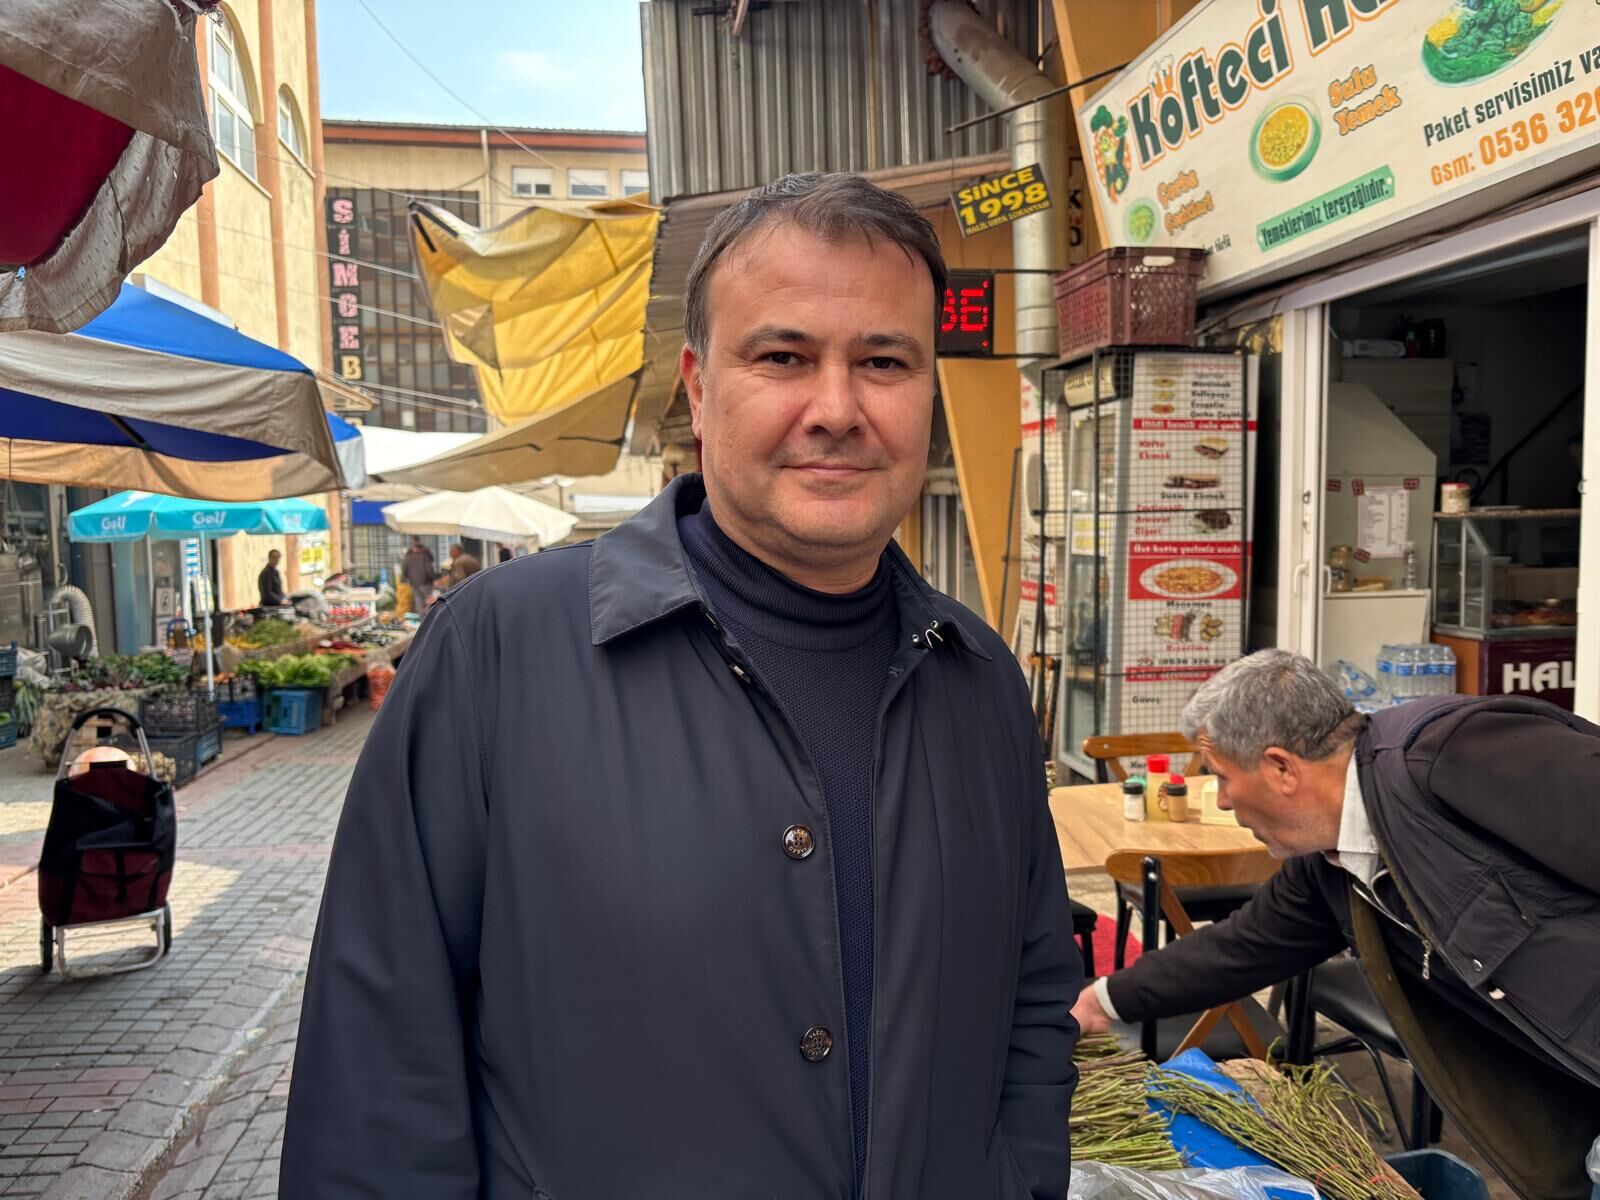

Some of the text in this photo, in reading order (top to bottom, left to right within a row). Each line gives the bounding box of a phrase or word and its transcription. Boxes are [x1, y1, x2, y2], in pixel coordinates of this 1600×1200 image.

[1328, 64, 1377, 108] Sulu
[1333, 84, 1402, 136] Yemek
[1424, 107, 1471, 147] Paket
[1474, 60, 1574, 124] servisimiz
[1430, 84, 1600, 186] Gsm: 0536 32
[959, 183, 1047, 226] 1998
[1261, 206, 1322, 247] Yemeklerimiz
